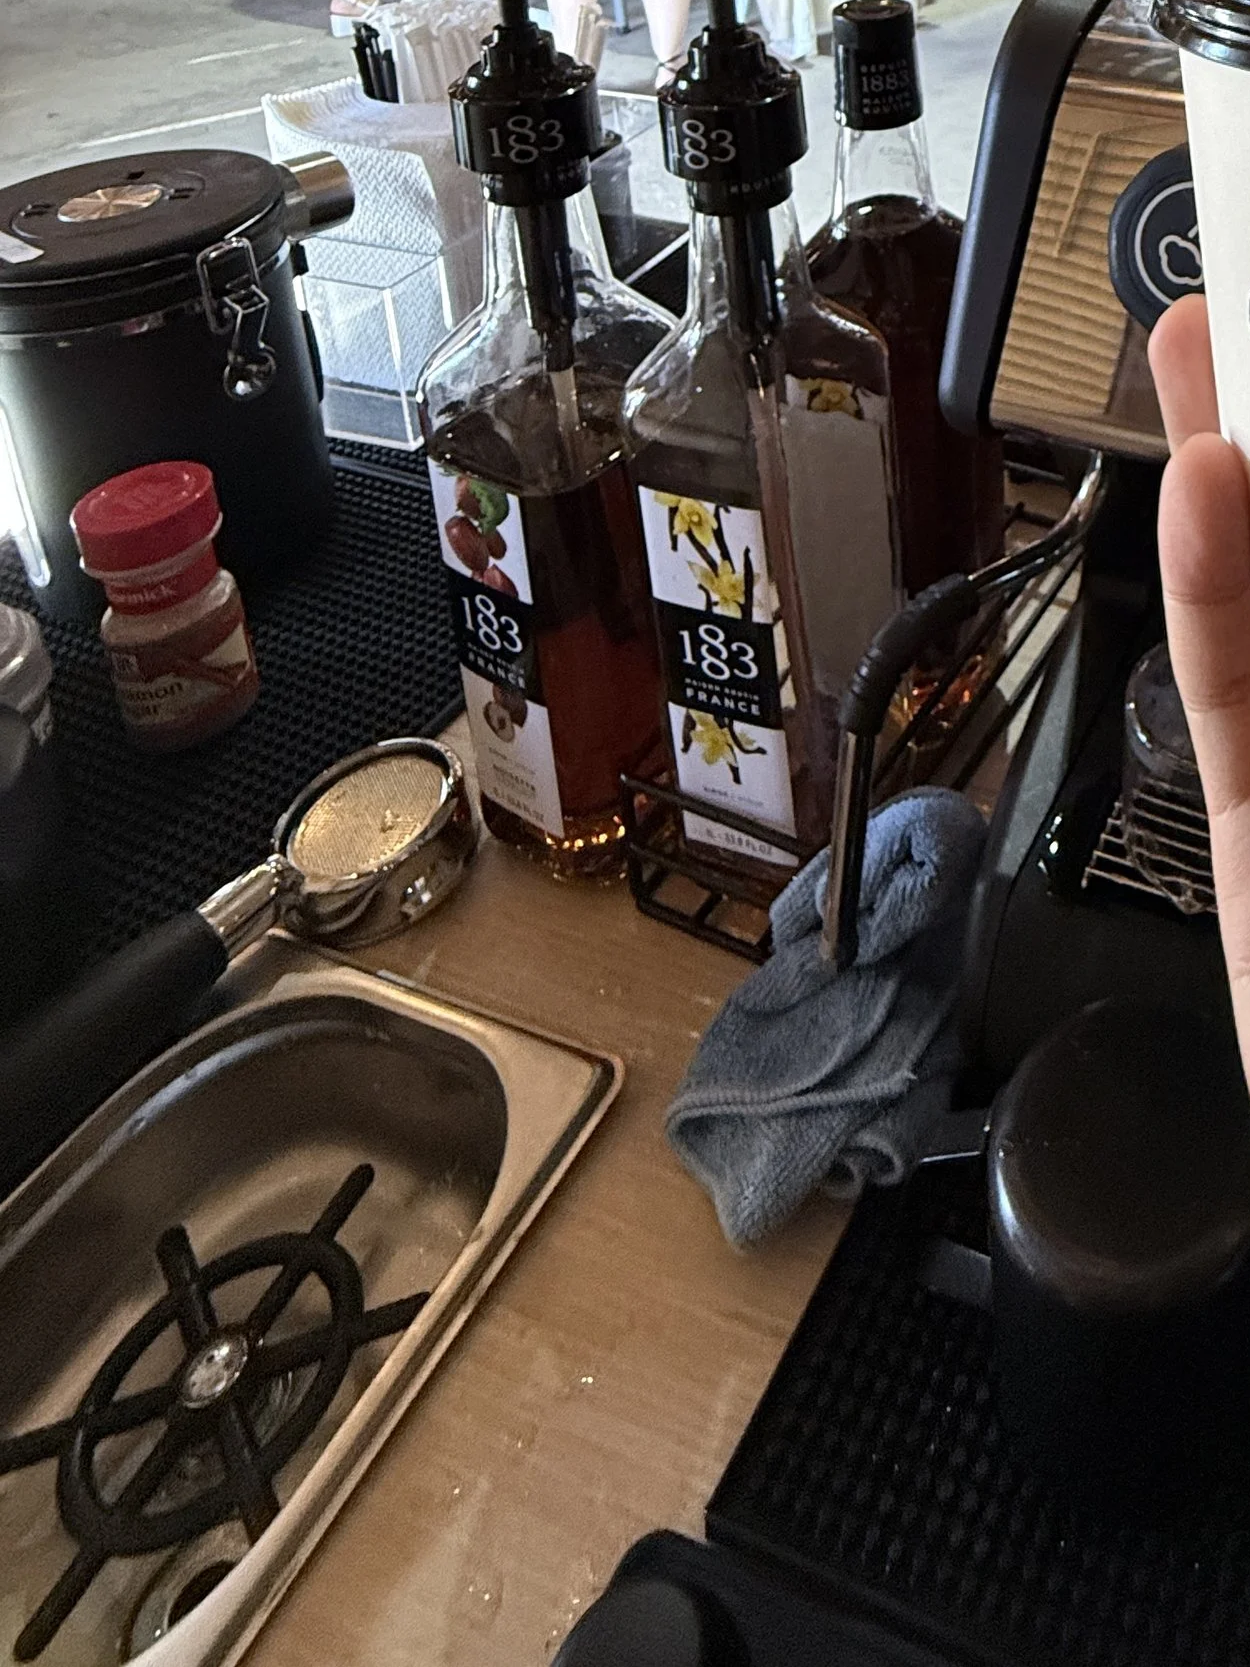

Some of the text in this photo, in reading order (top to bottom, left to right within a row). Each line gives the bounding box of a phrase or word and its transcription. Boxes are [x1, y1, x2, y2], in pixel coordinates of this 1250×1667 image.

[489, 115, 564, 164] 1883
[461, 594, 523, 652] 1883
[679, 623, 759, 681] 1883
[686, 687, 760, 716] FRANCE
